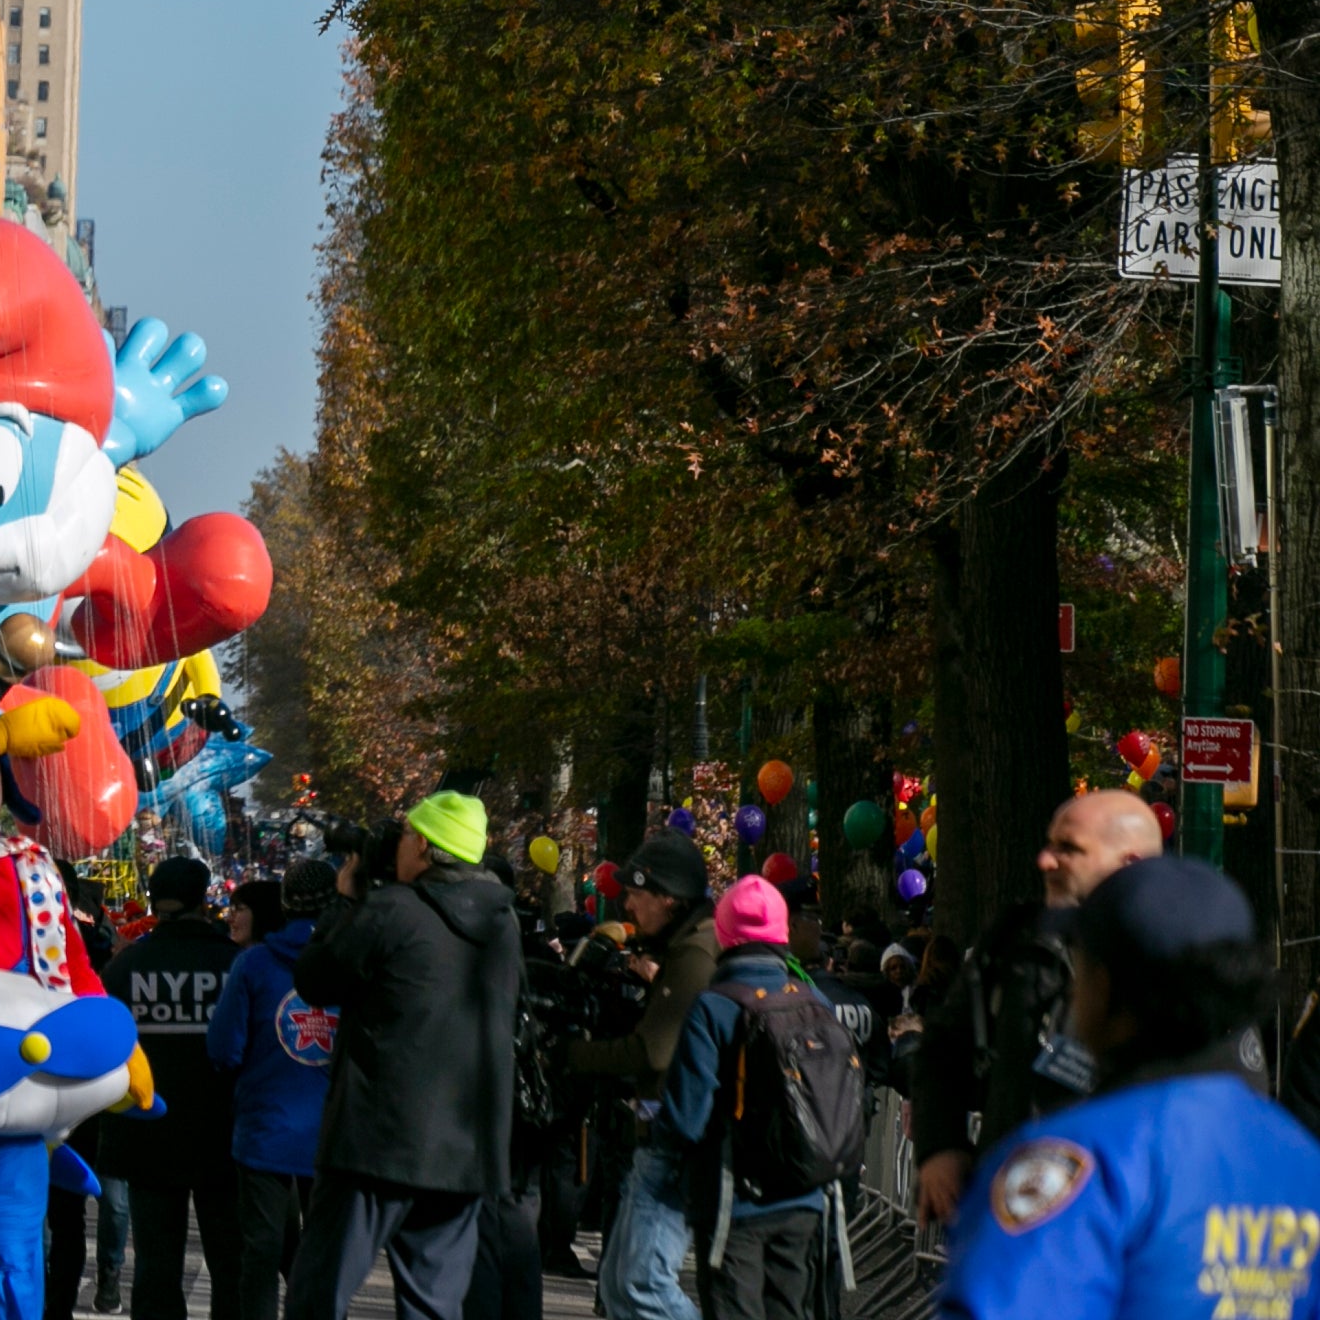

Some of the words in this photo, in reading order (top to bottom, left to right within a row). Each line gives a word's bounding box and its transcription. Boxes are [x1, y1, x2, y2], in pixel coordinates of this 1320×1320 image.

[1135, 219, 1201, 256] CAR
[1229, 225, 1282, 260] ONL
[1186, 724, 1199, 737] NO
[1200, 725, 1241, 739] STOPPING
[1186, 739, 1221, 754] Anytime
[1202, 1204, 1320, 1270] NYPD
